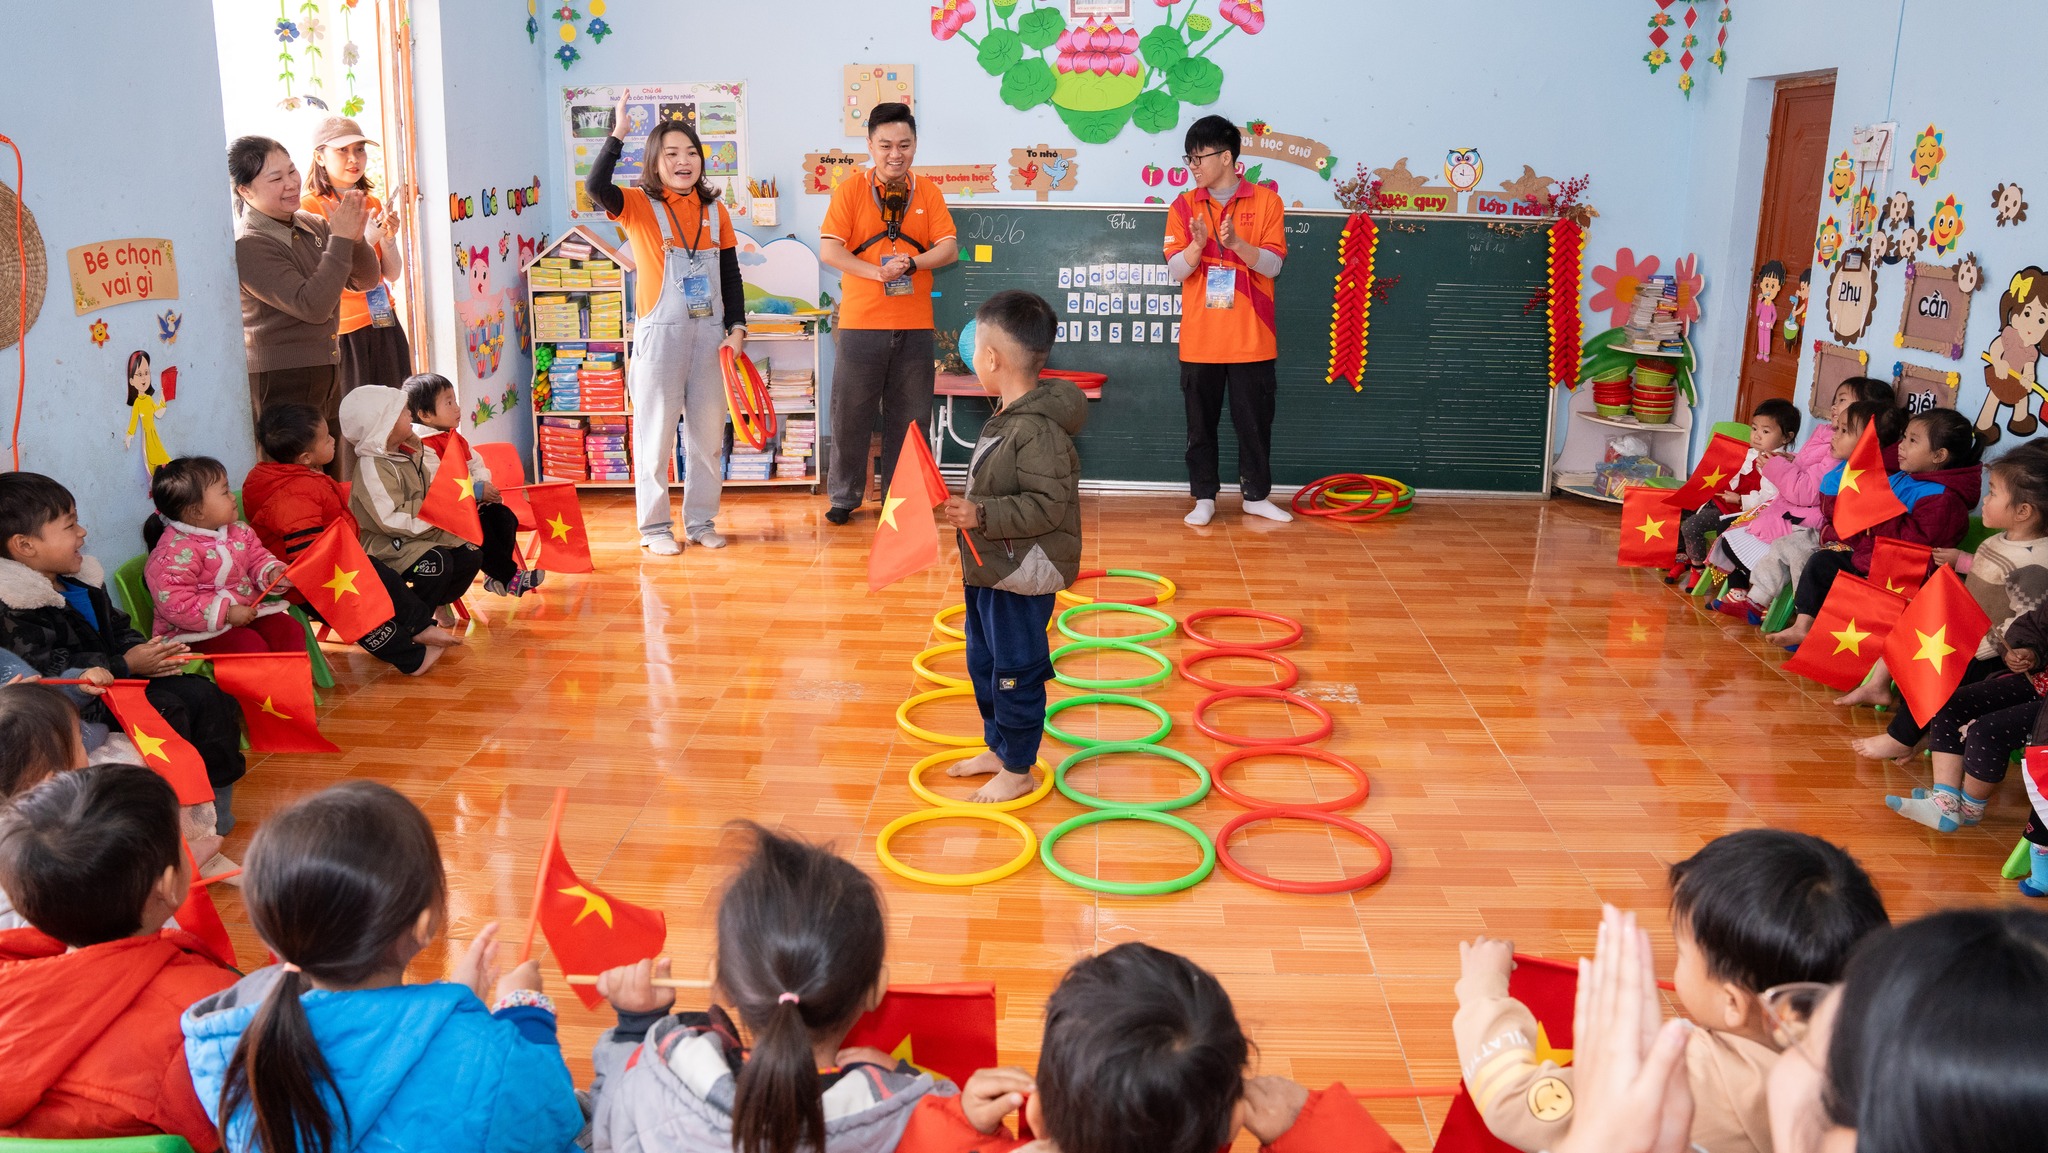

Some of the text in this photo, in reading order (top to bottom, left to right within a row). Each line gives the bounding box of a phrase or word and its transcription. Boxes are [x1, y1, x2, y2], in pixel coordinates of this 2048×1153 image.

[1026, 149, 1038, 158] To
[945, 173, 970, 183] toán
[972, 173, 990, 184] học
[481, 187, 499, 217] bé
[1414, 196, 1447, 212] quy
[1478, 197, 1508, 215] Lớp
[968, 213, 1025, 245] 2026
[1107, 213, 1137, 230] Thứ
[1295, 222, 1310, 234] 20
[83, 242, 162, 275] Bé chọn
[101, 270, 153, 299] vai gì
[1838, 281, 1862, 307] Phụ
[1918, 289, 1949, 319] cần
[1907, 388, 1937, 414] Biết
